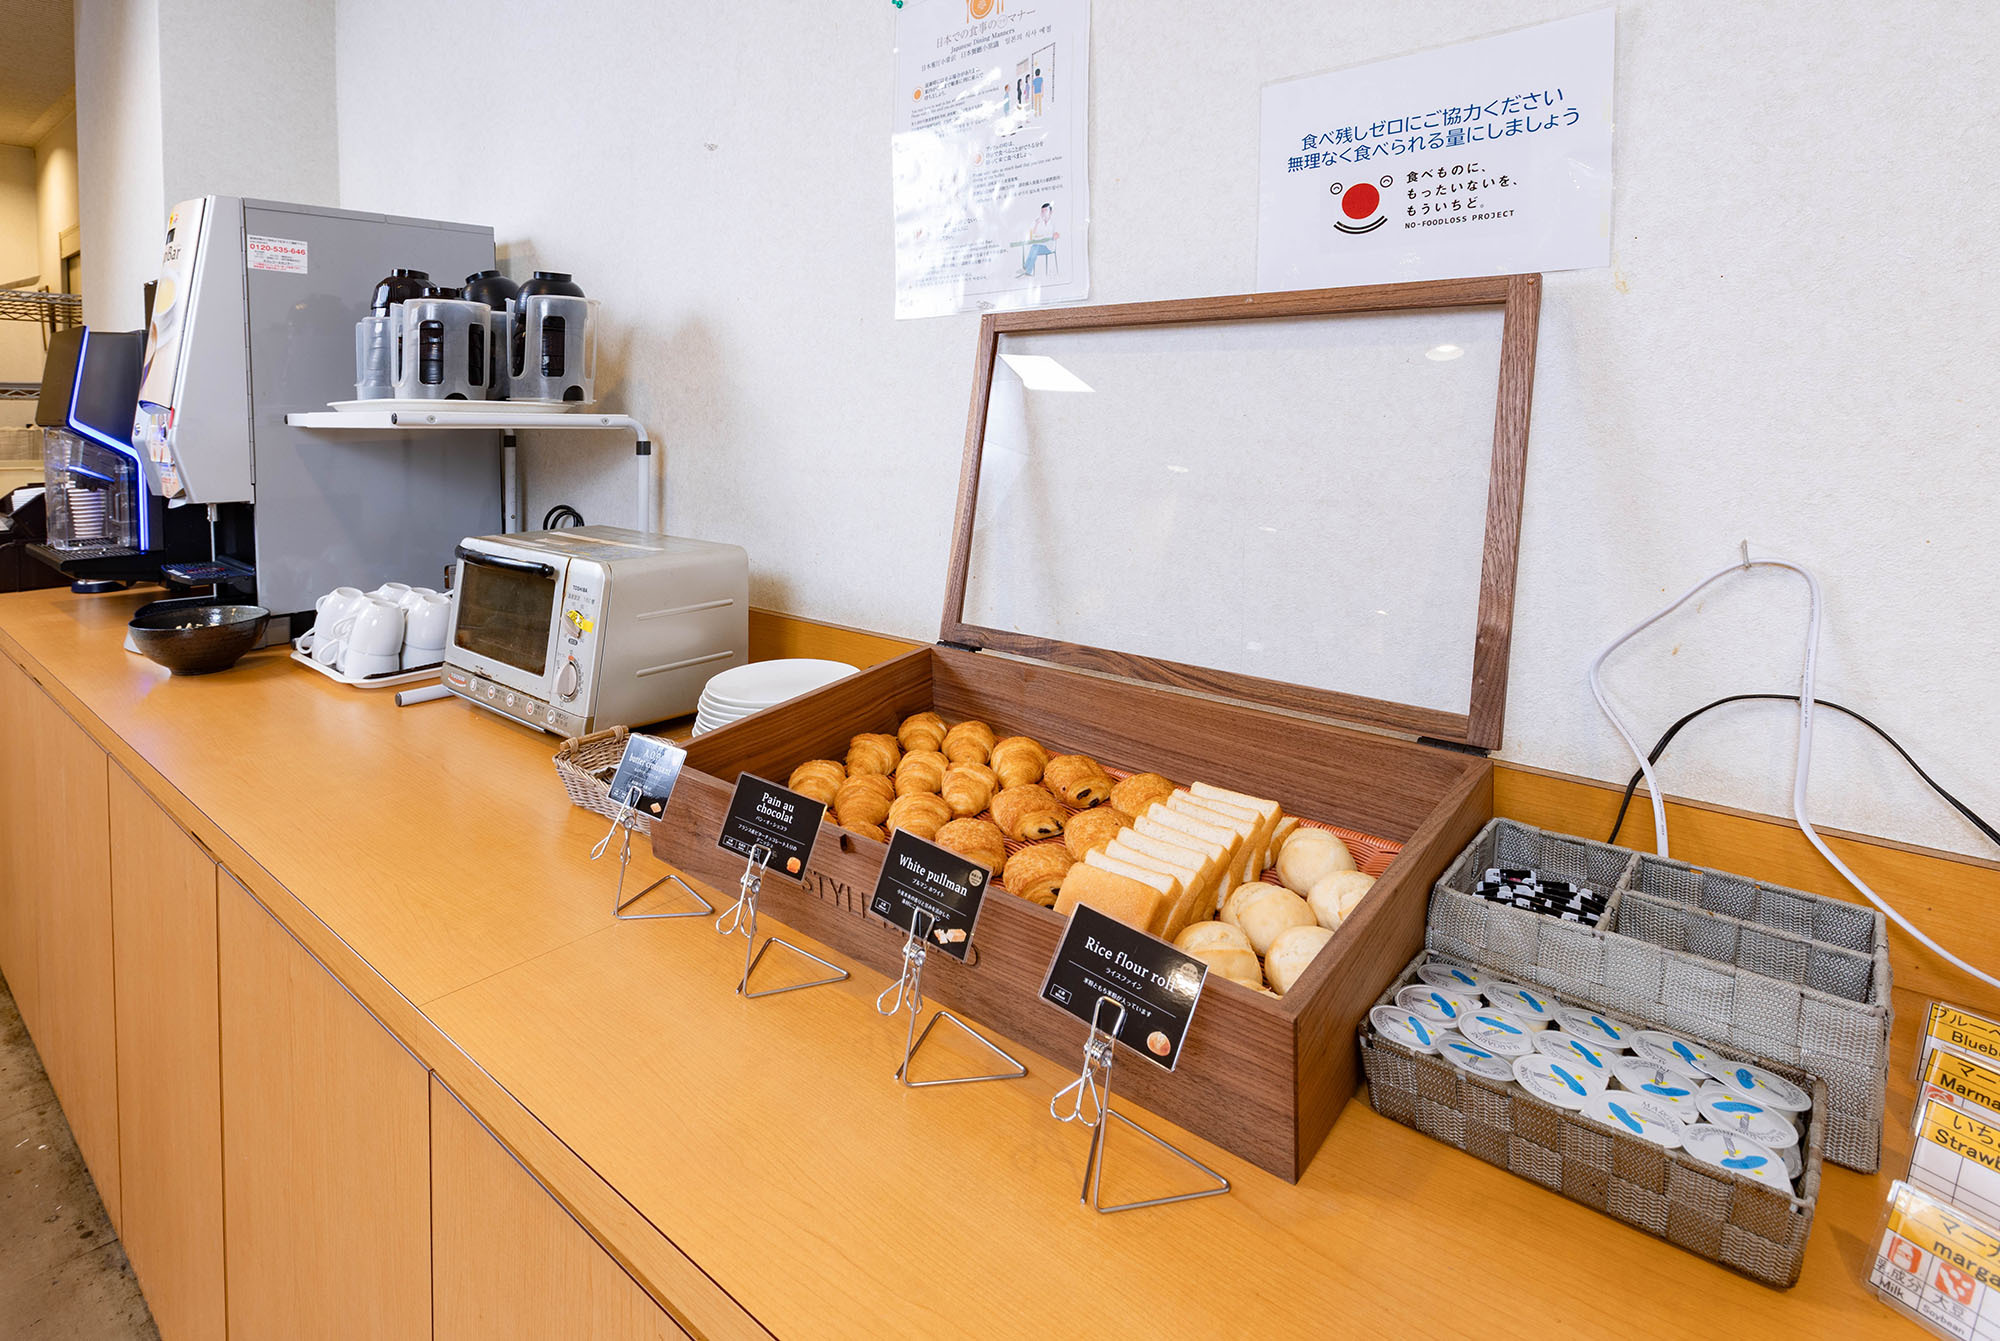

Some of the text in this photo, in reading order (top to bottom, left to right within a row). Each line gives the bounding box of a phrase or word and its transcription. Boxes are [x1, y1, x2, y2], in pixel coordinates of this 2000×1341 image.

[951, 28, 1015, 54] Japanese Dining Manners
[1301, 88, 1564, 151] 食べ残しゼロにご協力ください
[1287, 107, 1581, 173] 無理なく食べられる量にしましょう
[1406, 162, 1486, 184] 食べものに、
[1406, 175, 1518, 200] もったいないを、
[1404, 209, 1515, 230] NO-FOODLOSS PROJECT
[1406, 197, 1485, 217] もういちど。
[250, 243, 306, 255] 0120-535-646
[573, 584, 588, 593] TOSHIBA
[629, 752, 645, 766] butter
[645, 761, 672, 776] croissant
[756, 802, 794, 825] chocolat
[761, 791, 795, 812] Pain au
[899, 853, 926, 876] White
[926, 868, 968, 897] pullman
[1084, 936, 1113, 960] Rice
[1114, 951, 1149, 978] flour
[1150, 969, 1177, 993] roll
[1953, 1114, 2000, 1148] いち
[1876, 1259, 1923, 1293] 乳成分
[1933, 1241, 2000, 1288] marga
[1879, 1275, 1905, 1300] Milk
[1931, 1293, 1965, 1320] 大豆
[1922, 1303, 1965, 1336] Soybean
